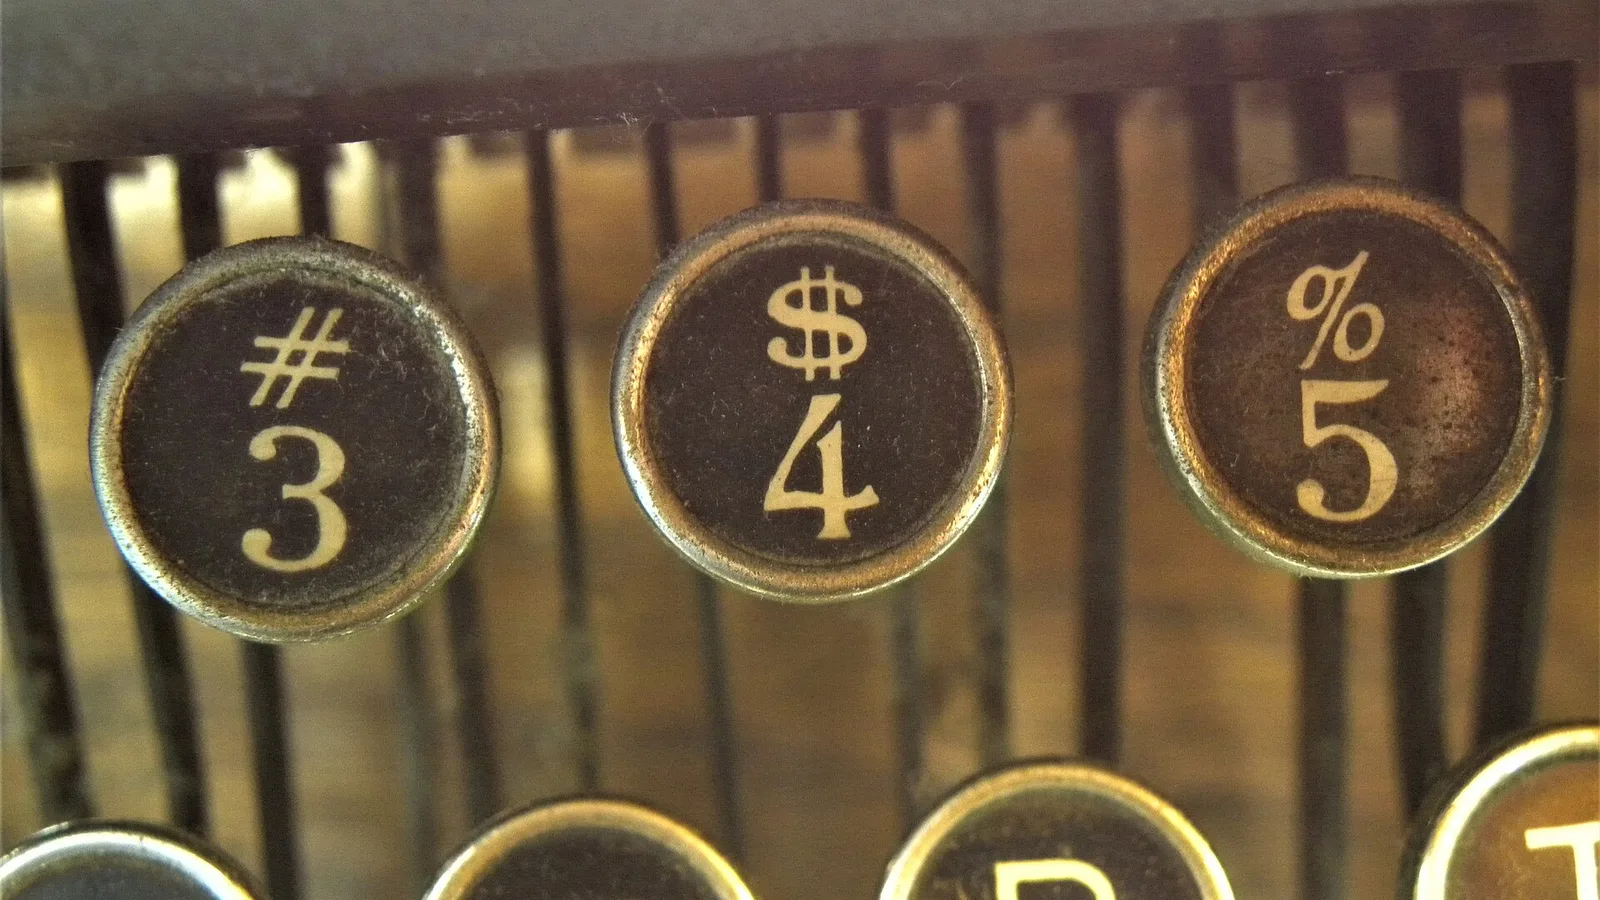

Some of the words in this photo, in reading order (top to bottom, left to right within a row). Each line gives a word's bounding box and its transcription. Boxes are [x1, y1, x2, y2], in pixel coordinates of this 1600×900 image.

[240, 307, 351, 409] #
[766, 265, 868, 382] $
[1286, 251, 1385, 370] %
[241, 426, 348, 572] 3
[763, 393, 880, 540] 4
[1296, 379, 1399, 522] 5
